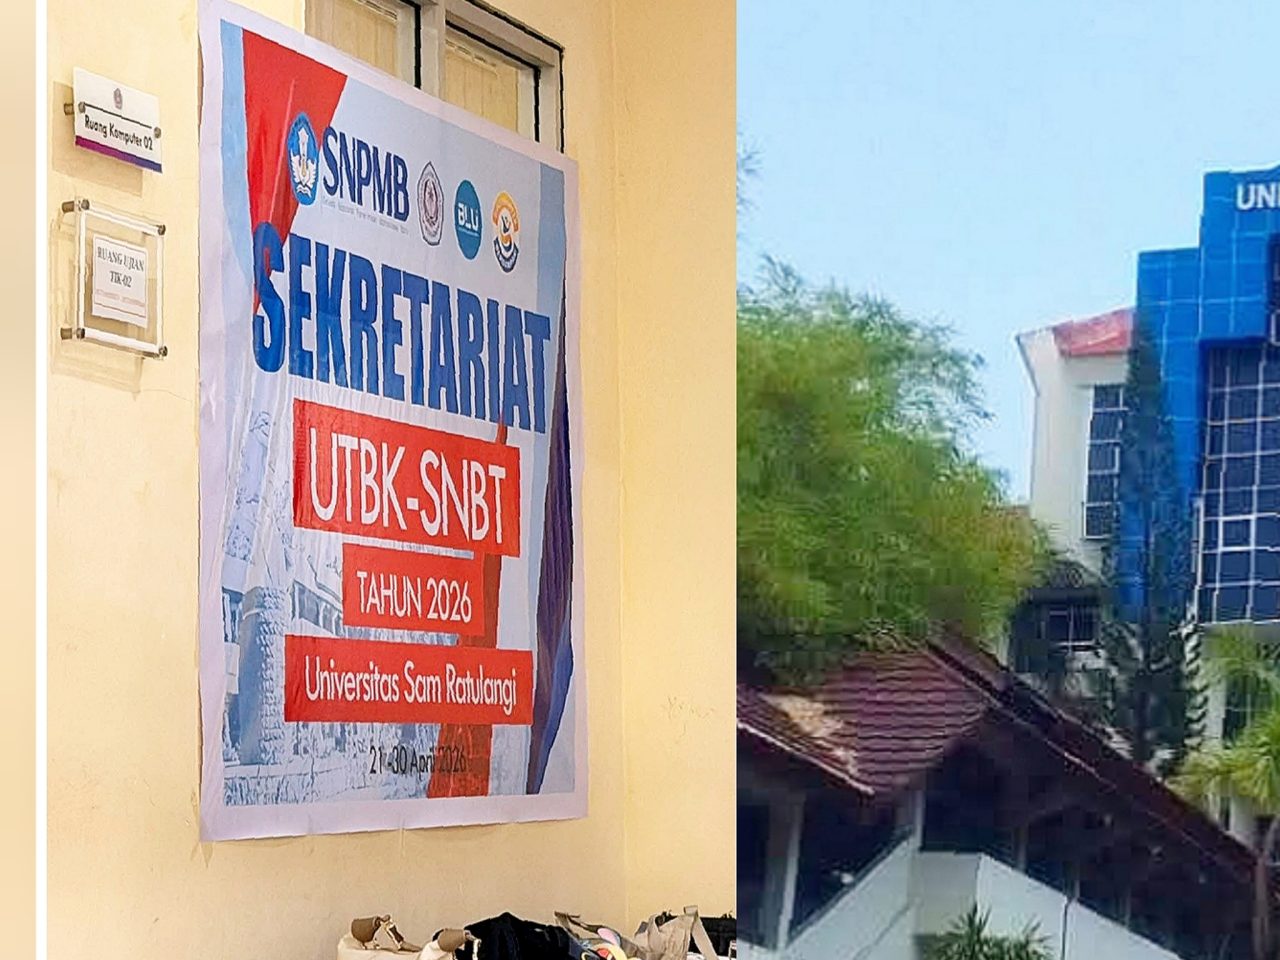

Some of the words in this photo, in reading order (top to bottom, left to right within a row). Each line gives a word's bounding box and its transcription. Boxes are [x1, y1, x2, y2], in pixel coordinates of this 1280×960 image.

[85, 114, 107, 138] Ruang
[109, 122, 142, 147] Komputer
[144, 135, 153, 150] 02
[322, 126, 410, 222] SNPMB
[457, 203, 479, 231] BLU
[97, 246, 123, 265] RUANG
[123, 254, 145, 272] UJIAN
[109, 270, 133, 288] TIK-02
[253, 222, 551, 434] SEKRETARIAT
[308, 427, 506, 544] UTBK-SNBT
[356, 571, 422, 620] TAHUN
[427, 579, 472, 623] 2026
[304, 655, 400, 702] Universitas
[404, 660, 441, 704] Sam
[446, 663, 517, 716] Ratulangi
[410, 747, 436, 781] April
[438, 746, 467, 774] 2026
